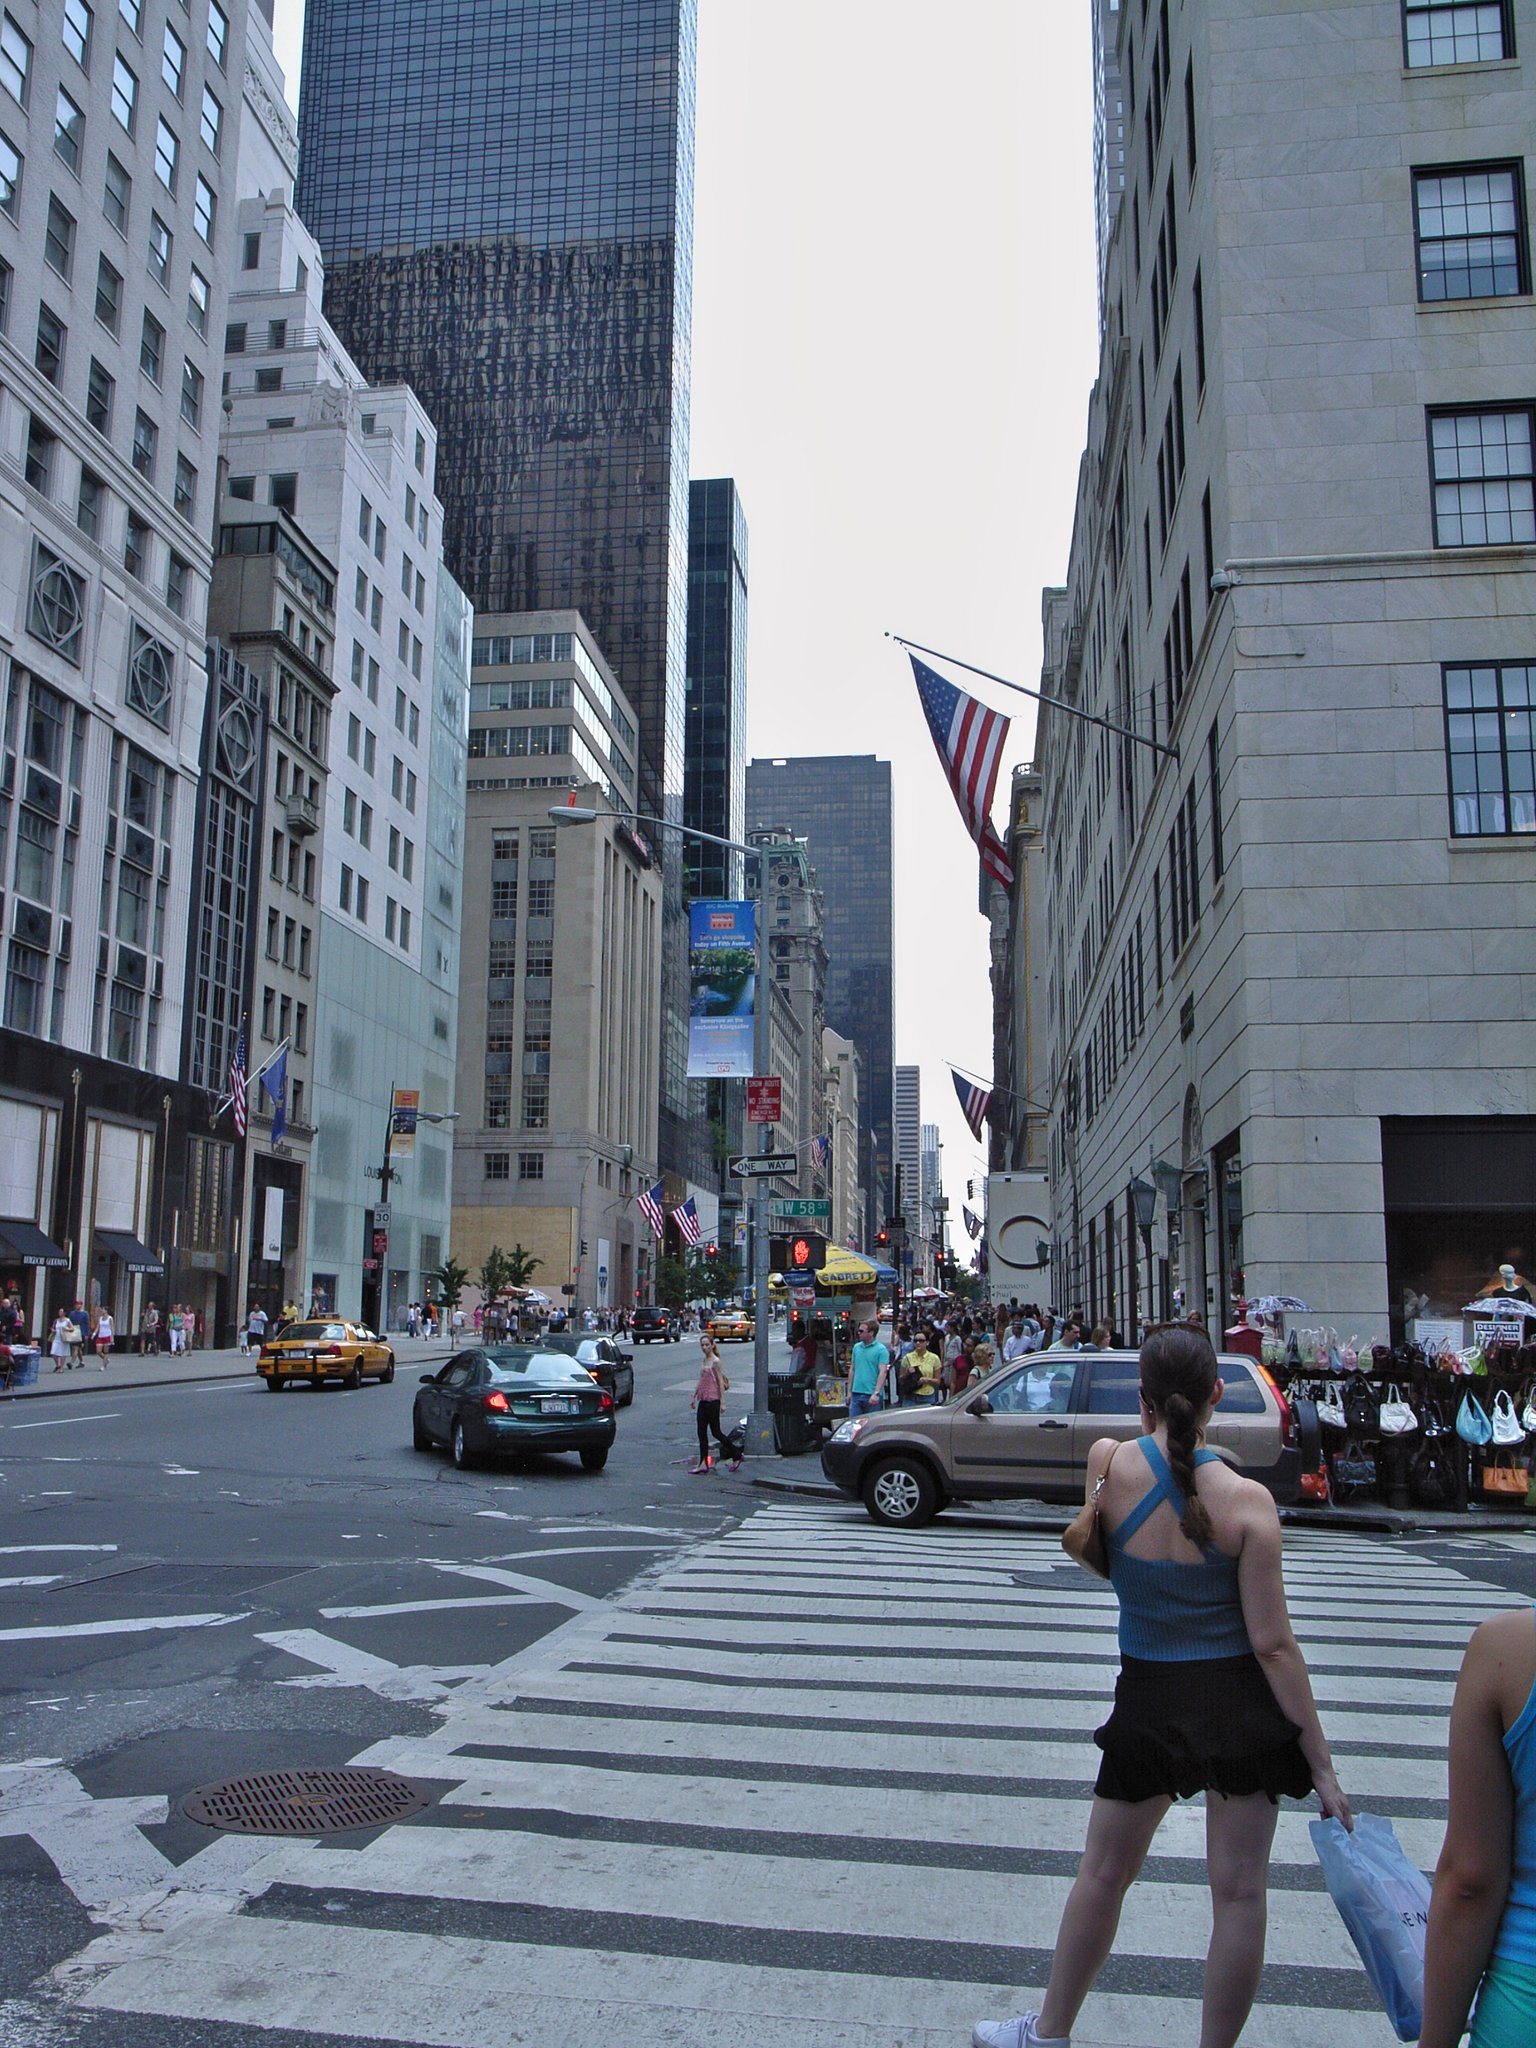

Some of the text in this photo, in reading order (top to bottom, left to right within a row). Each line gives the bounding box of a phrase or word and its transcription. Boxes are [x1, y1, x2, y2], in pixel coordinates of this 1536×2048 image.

[737, 1160, 787, 1172] ONE WAY
[784, 1201, 794, 1215] W
[799, 1202, 815, 1215] 58
[375, 1213, 390, 1222] 30
[822, 1271, 873, 1282] SABRETT
